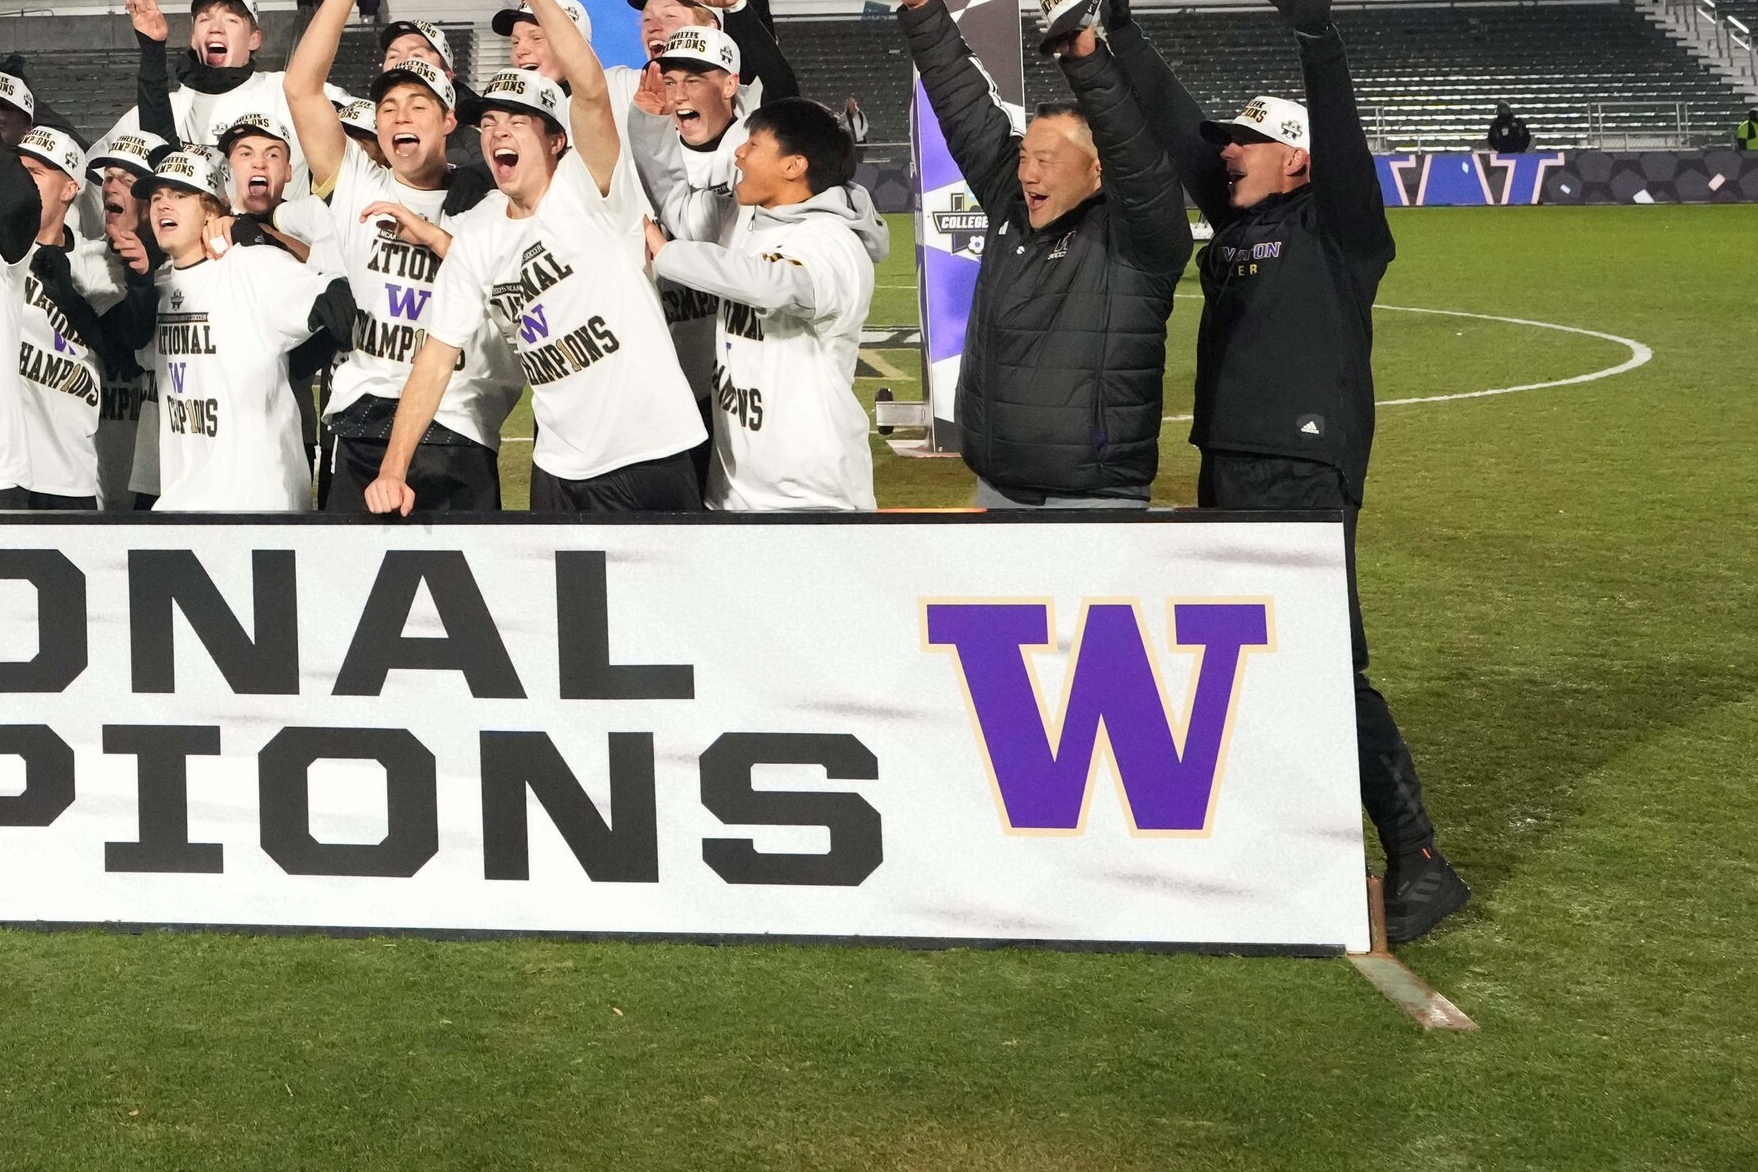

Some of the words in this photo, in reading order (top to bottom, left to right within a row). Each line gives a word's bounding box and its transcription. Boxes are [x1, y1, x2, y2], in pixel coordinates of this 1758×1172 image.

[380, 230, 398, 240] NCAA
[941, 215, 989, 229] COLLEGE
[385, 282, 432, 321] W
[520, 303, 549, 344] W
[168, 362, 187, 394] W
[918, 596, 1277, 839] W
